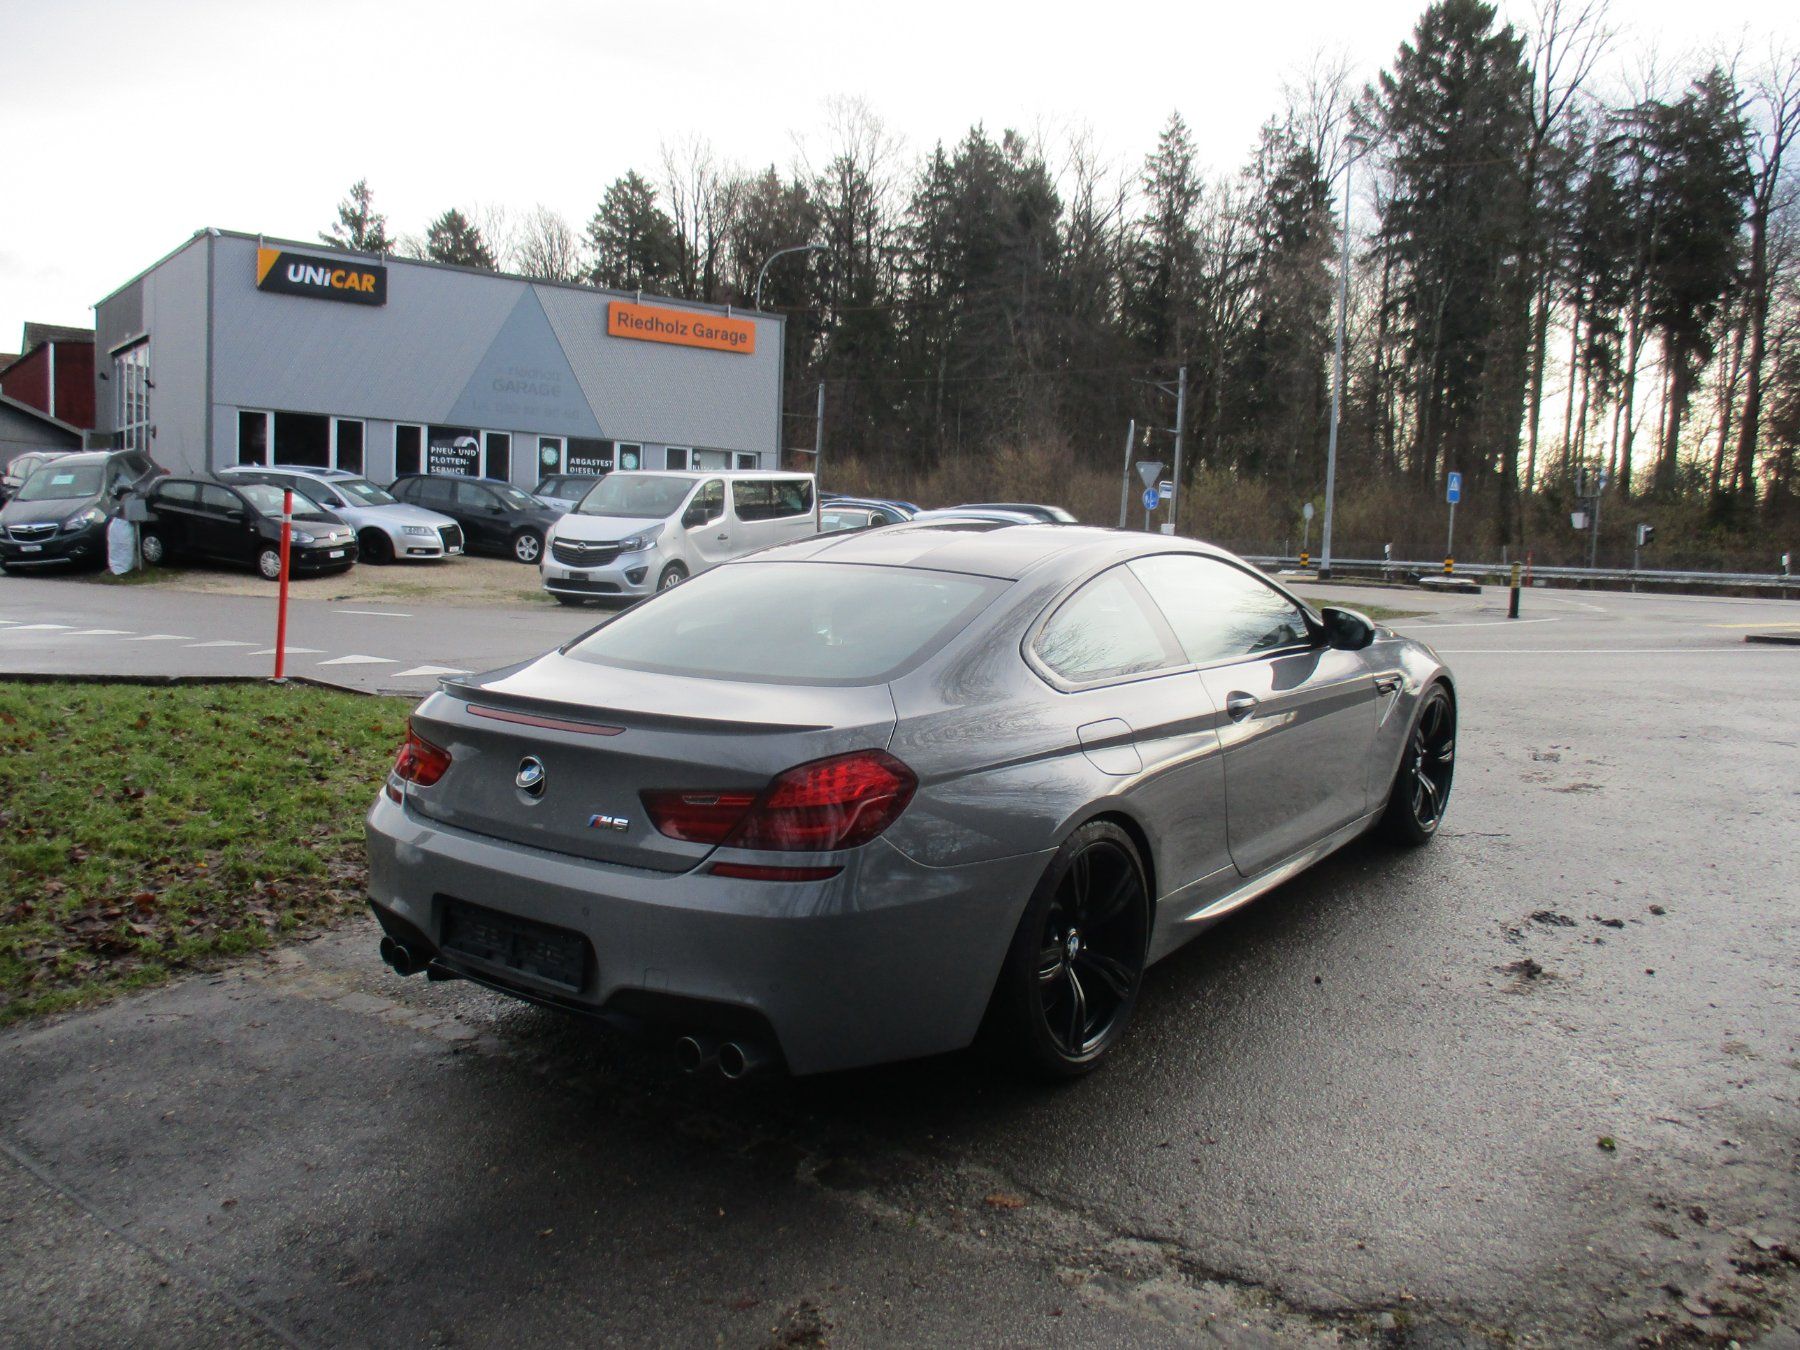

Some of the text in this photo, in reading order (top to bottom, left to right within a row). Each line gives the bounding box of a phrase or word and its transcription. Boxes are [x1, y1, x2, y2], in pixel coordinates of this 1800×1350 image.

[617, 311, 748, 345] Riedholz Garage
[492, 378, 561, 397] GARAGE
[430, 446, 477, 456] PNEU- UND
[430, 456, 470, 465] FLOTTEN-
[569, 457, 614, 467] ABGASTEST
[430, 466, 466, 475] SERVICE
[569, 466, 596, 475] DIESEL
